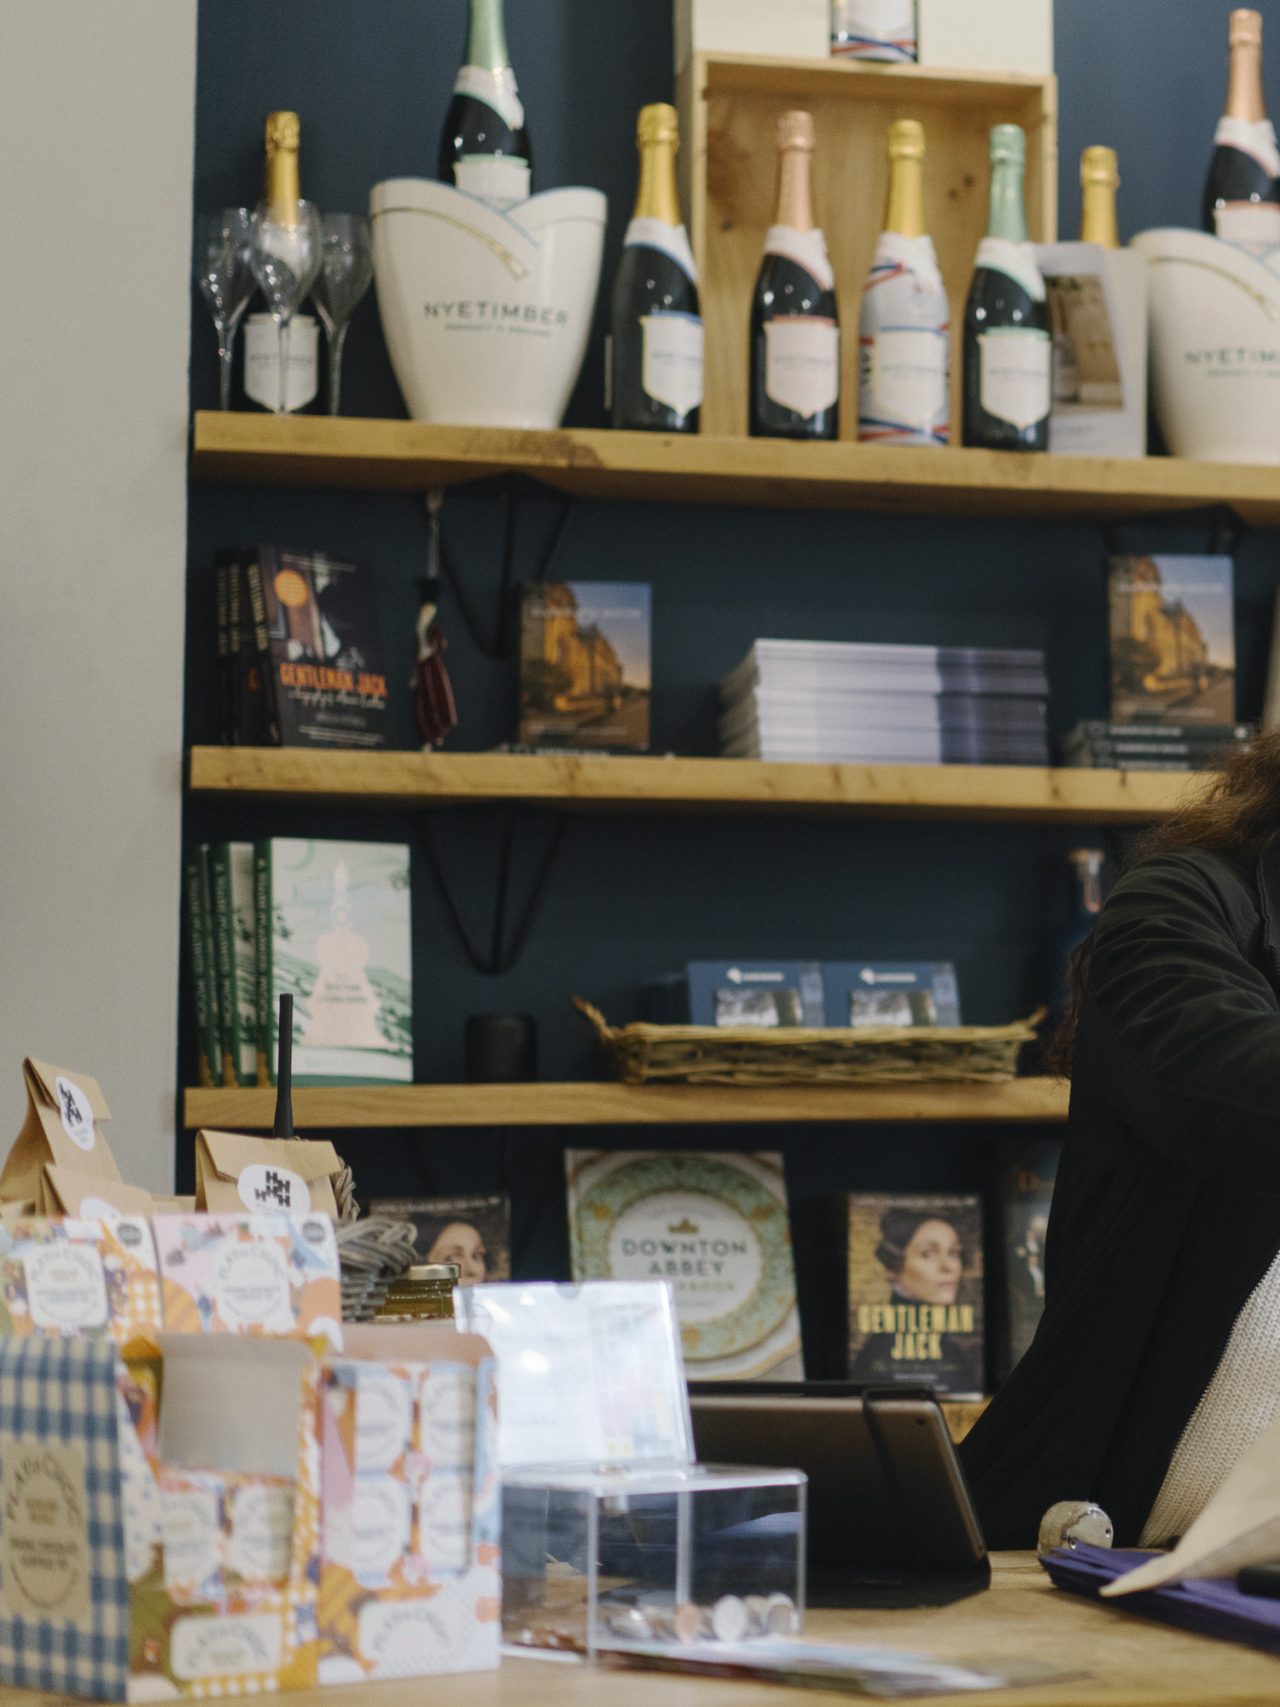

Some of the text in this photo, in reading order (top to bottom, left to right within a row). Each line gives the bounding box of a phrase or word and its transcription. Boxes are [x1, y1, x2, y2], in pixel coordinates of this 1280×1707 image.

[424, 301, 570, 327] NYETIMBER
[622, 1239, 747, 1256] DOWNTON
[649, 1261, 724, 1276] ABBEY
[857, 1304, 974, 1333] GENTLEMAN
[890, 1333, 943, 1360] JACK
